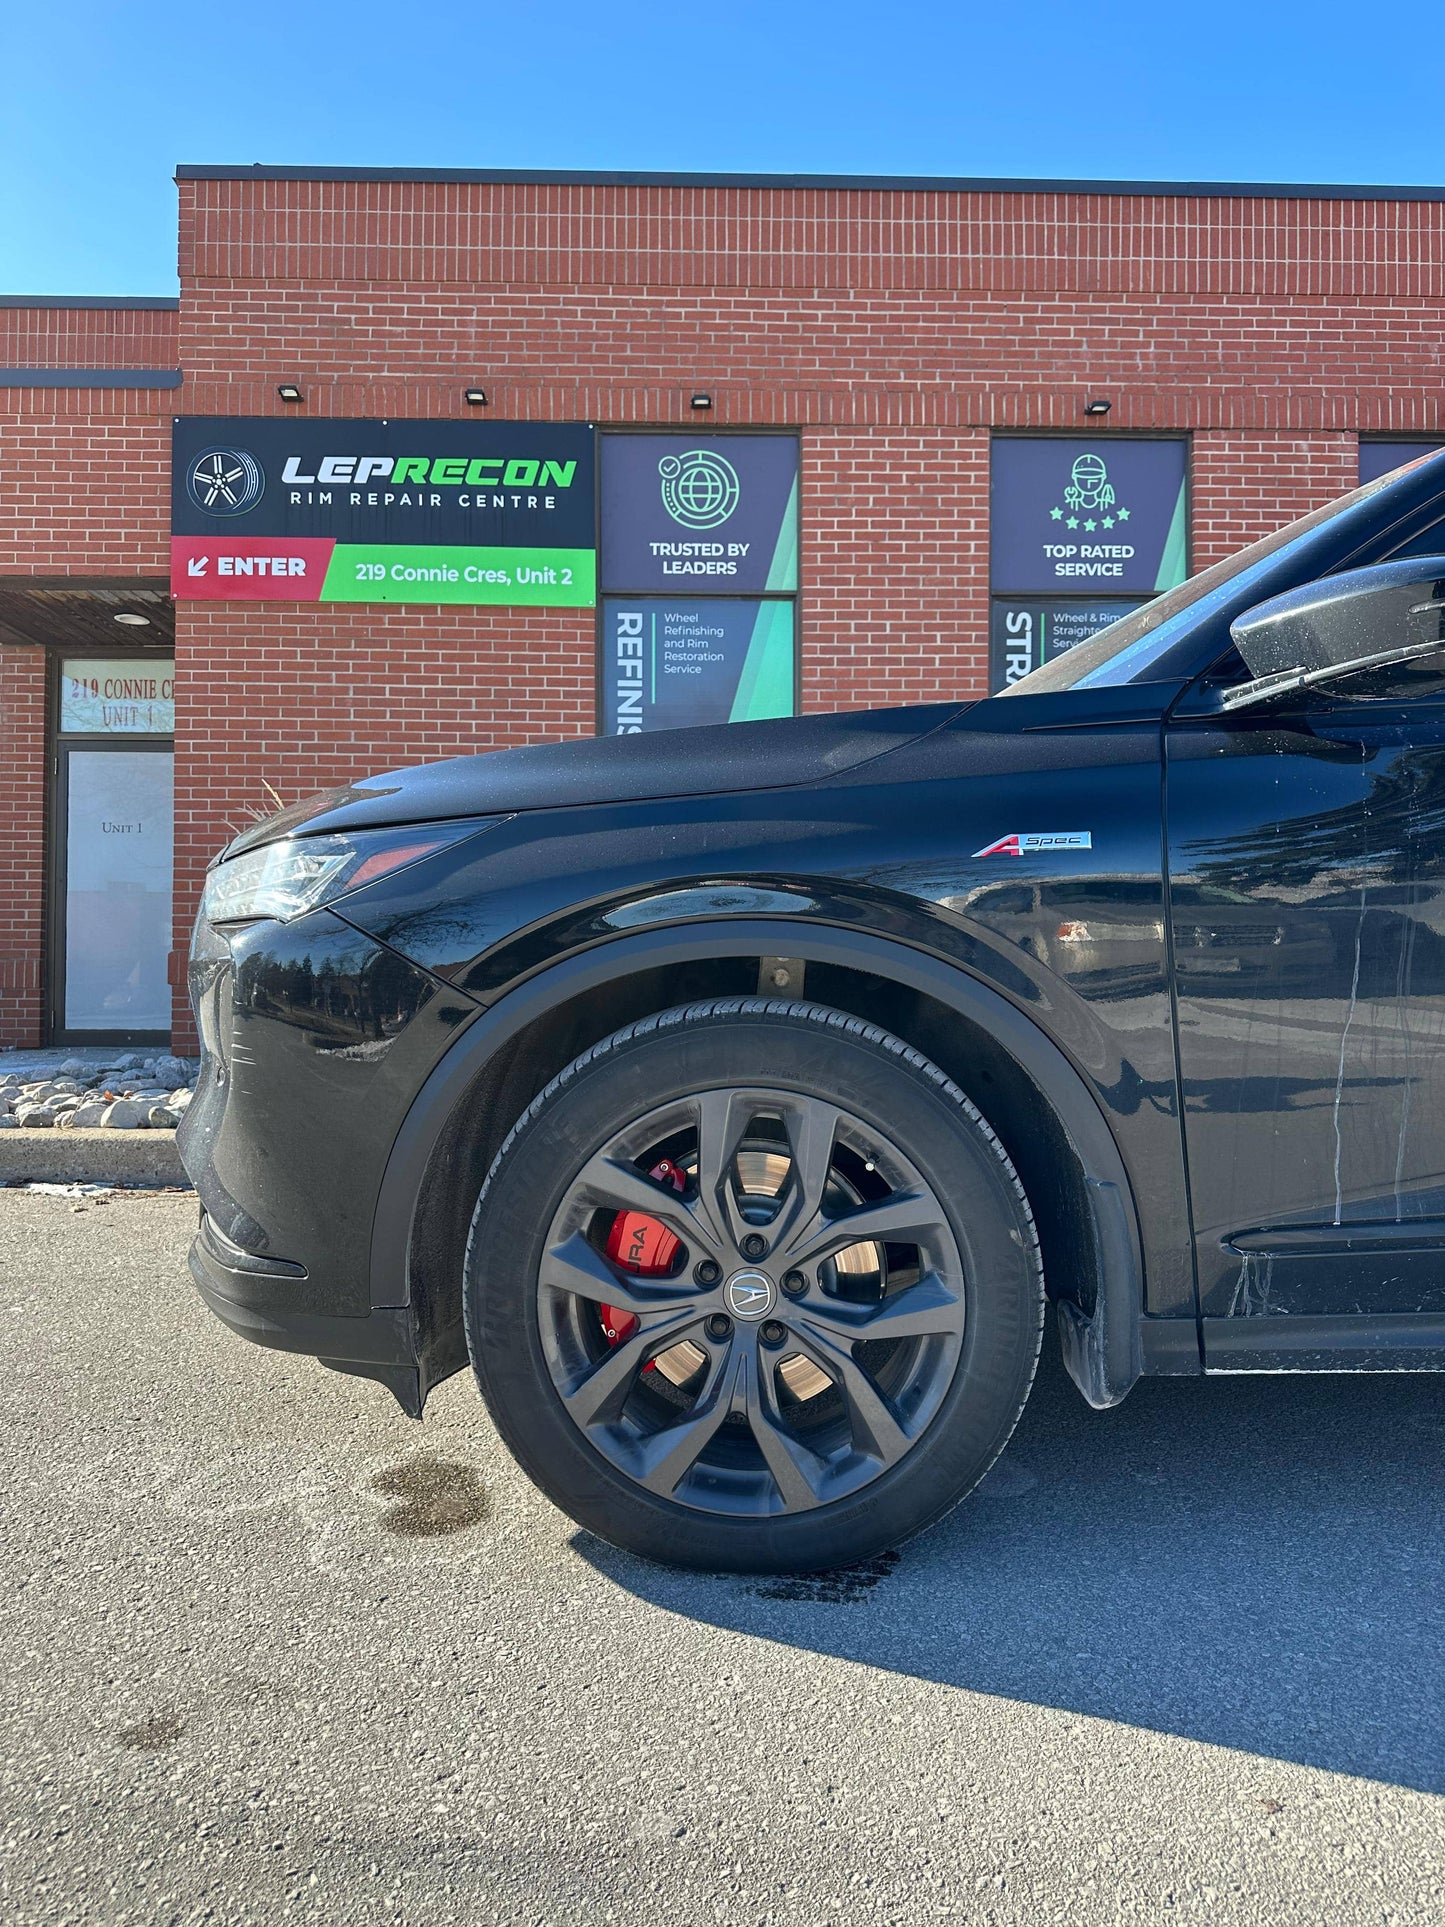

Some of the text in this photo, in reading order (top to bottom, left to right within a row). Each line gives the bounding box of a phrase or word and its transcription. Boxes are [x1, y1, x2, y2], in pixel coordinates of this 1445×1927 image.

[281, 456, 578, 488] LEPRECON
[290, 491, 556, 509] RIM REPAIR CENTRE
[649, 542, 750, 557] TRUSTED BY
[1042, 544, 1135, 558] TOP RATED
[217, 556, 307, 577] ENTER
[663, 561, 737, 575] LEADERS
[1055, 562, 1123, 577] SERVICE
[355, 563, 573, 586] 219 Connie Cres, Unit 2
[664, 612, 699, 623] Wheel
[1053, 612, 1121, 623] Wheel & Rim
[664, 625, 725, 638] Refinishing
[664, 638, 709, 648] and Rim
[664, 651, 725, 661] Restoration
[664, 663, 702, 674] Service
[72, 678, 99, 699] 219
[104, 678, 157, 699] CONNIE
[103, 704, 154, 727] UNIT 1
